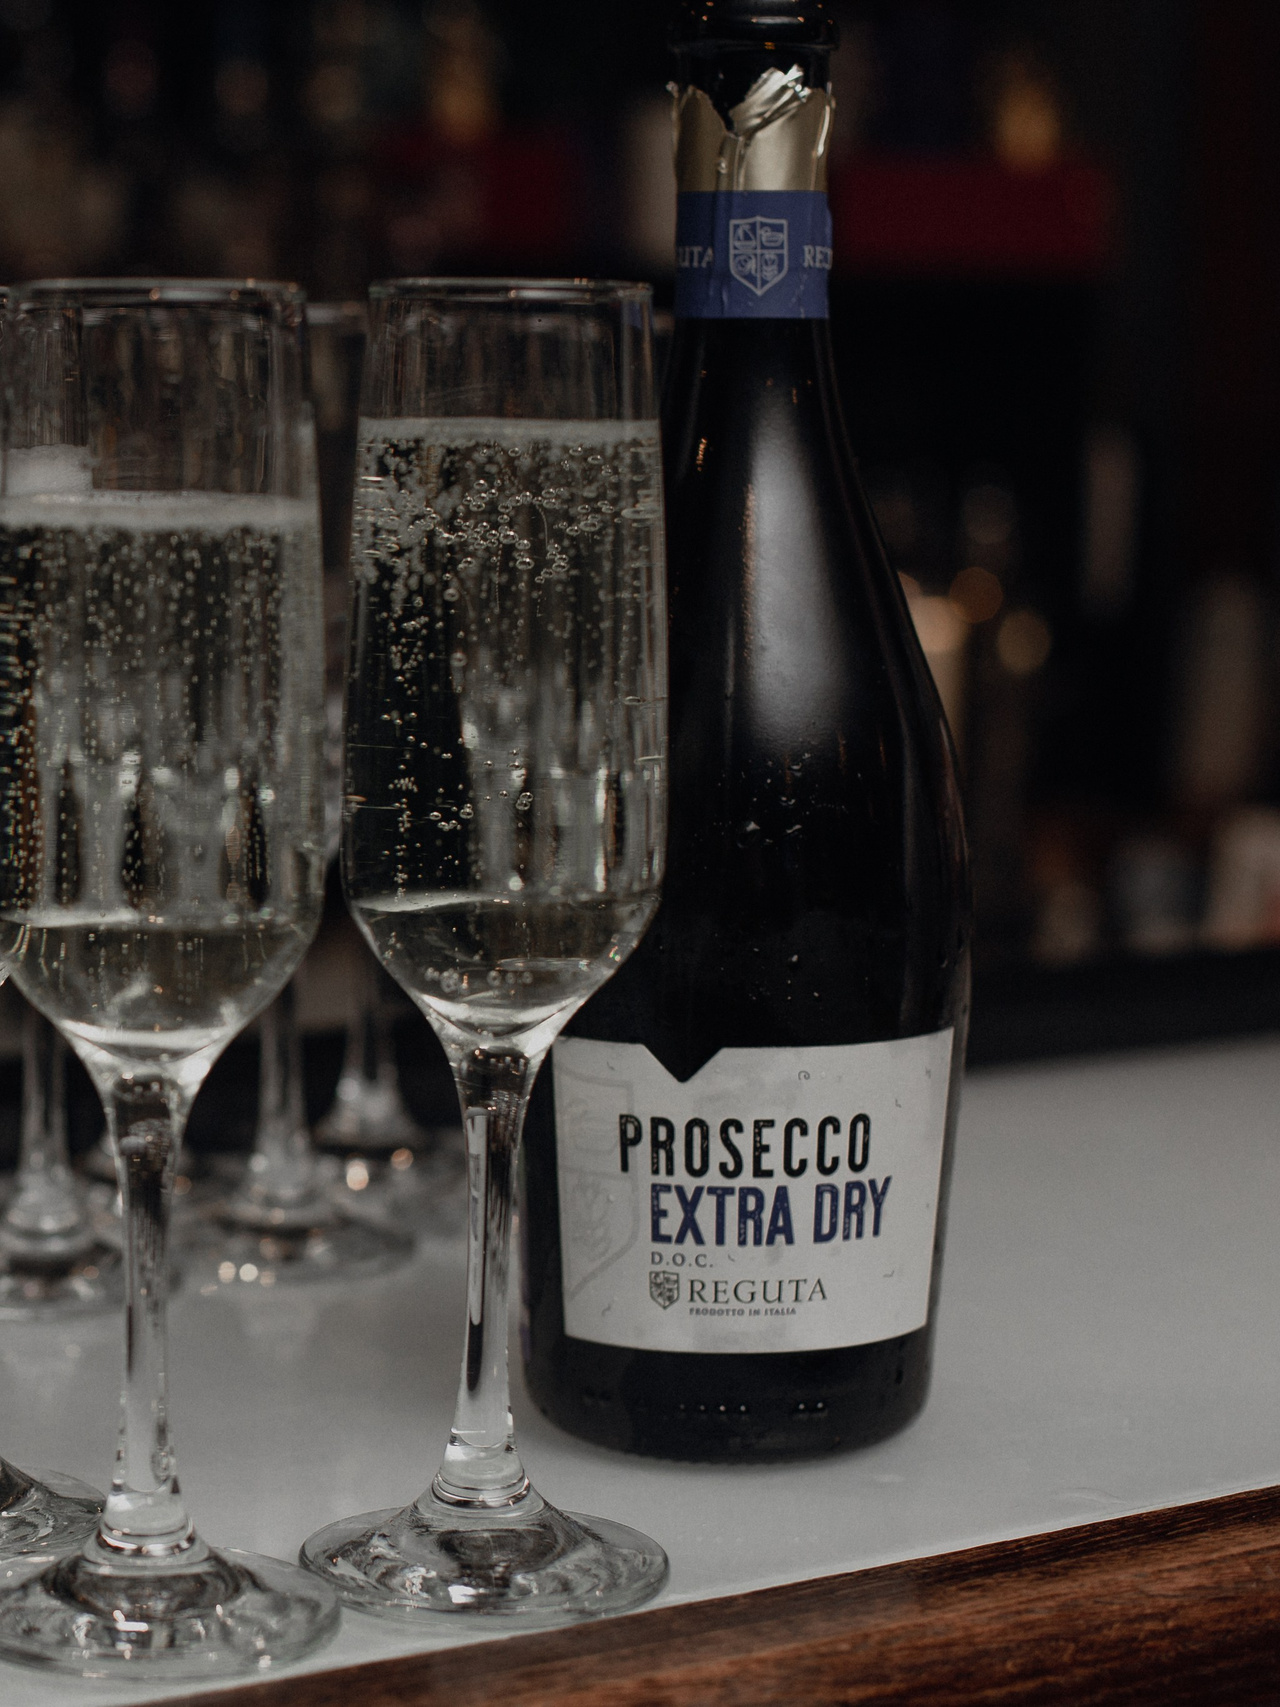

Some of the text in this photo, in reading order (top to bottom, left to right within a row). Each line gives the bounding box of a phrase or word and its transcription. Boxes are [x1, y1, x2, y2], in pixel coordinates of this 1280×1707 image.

[619, 1113, 870, 1178] PROSECCO
[651, 1175, 892, 1246] EXTRA DRY
[650, 1251, 714, 1268] D.O.C.
[688, 1278, 827, 1304] REGUTA
[689, 1306, 797, 1317] PRODOTTO IN ITALIA
